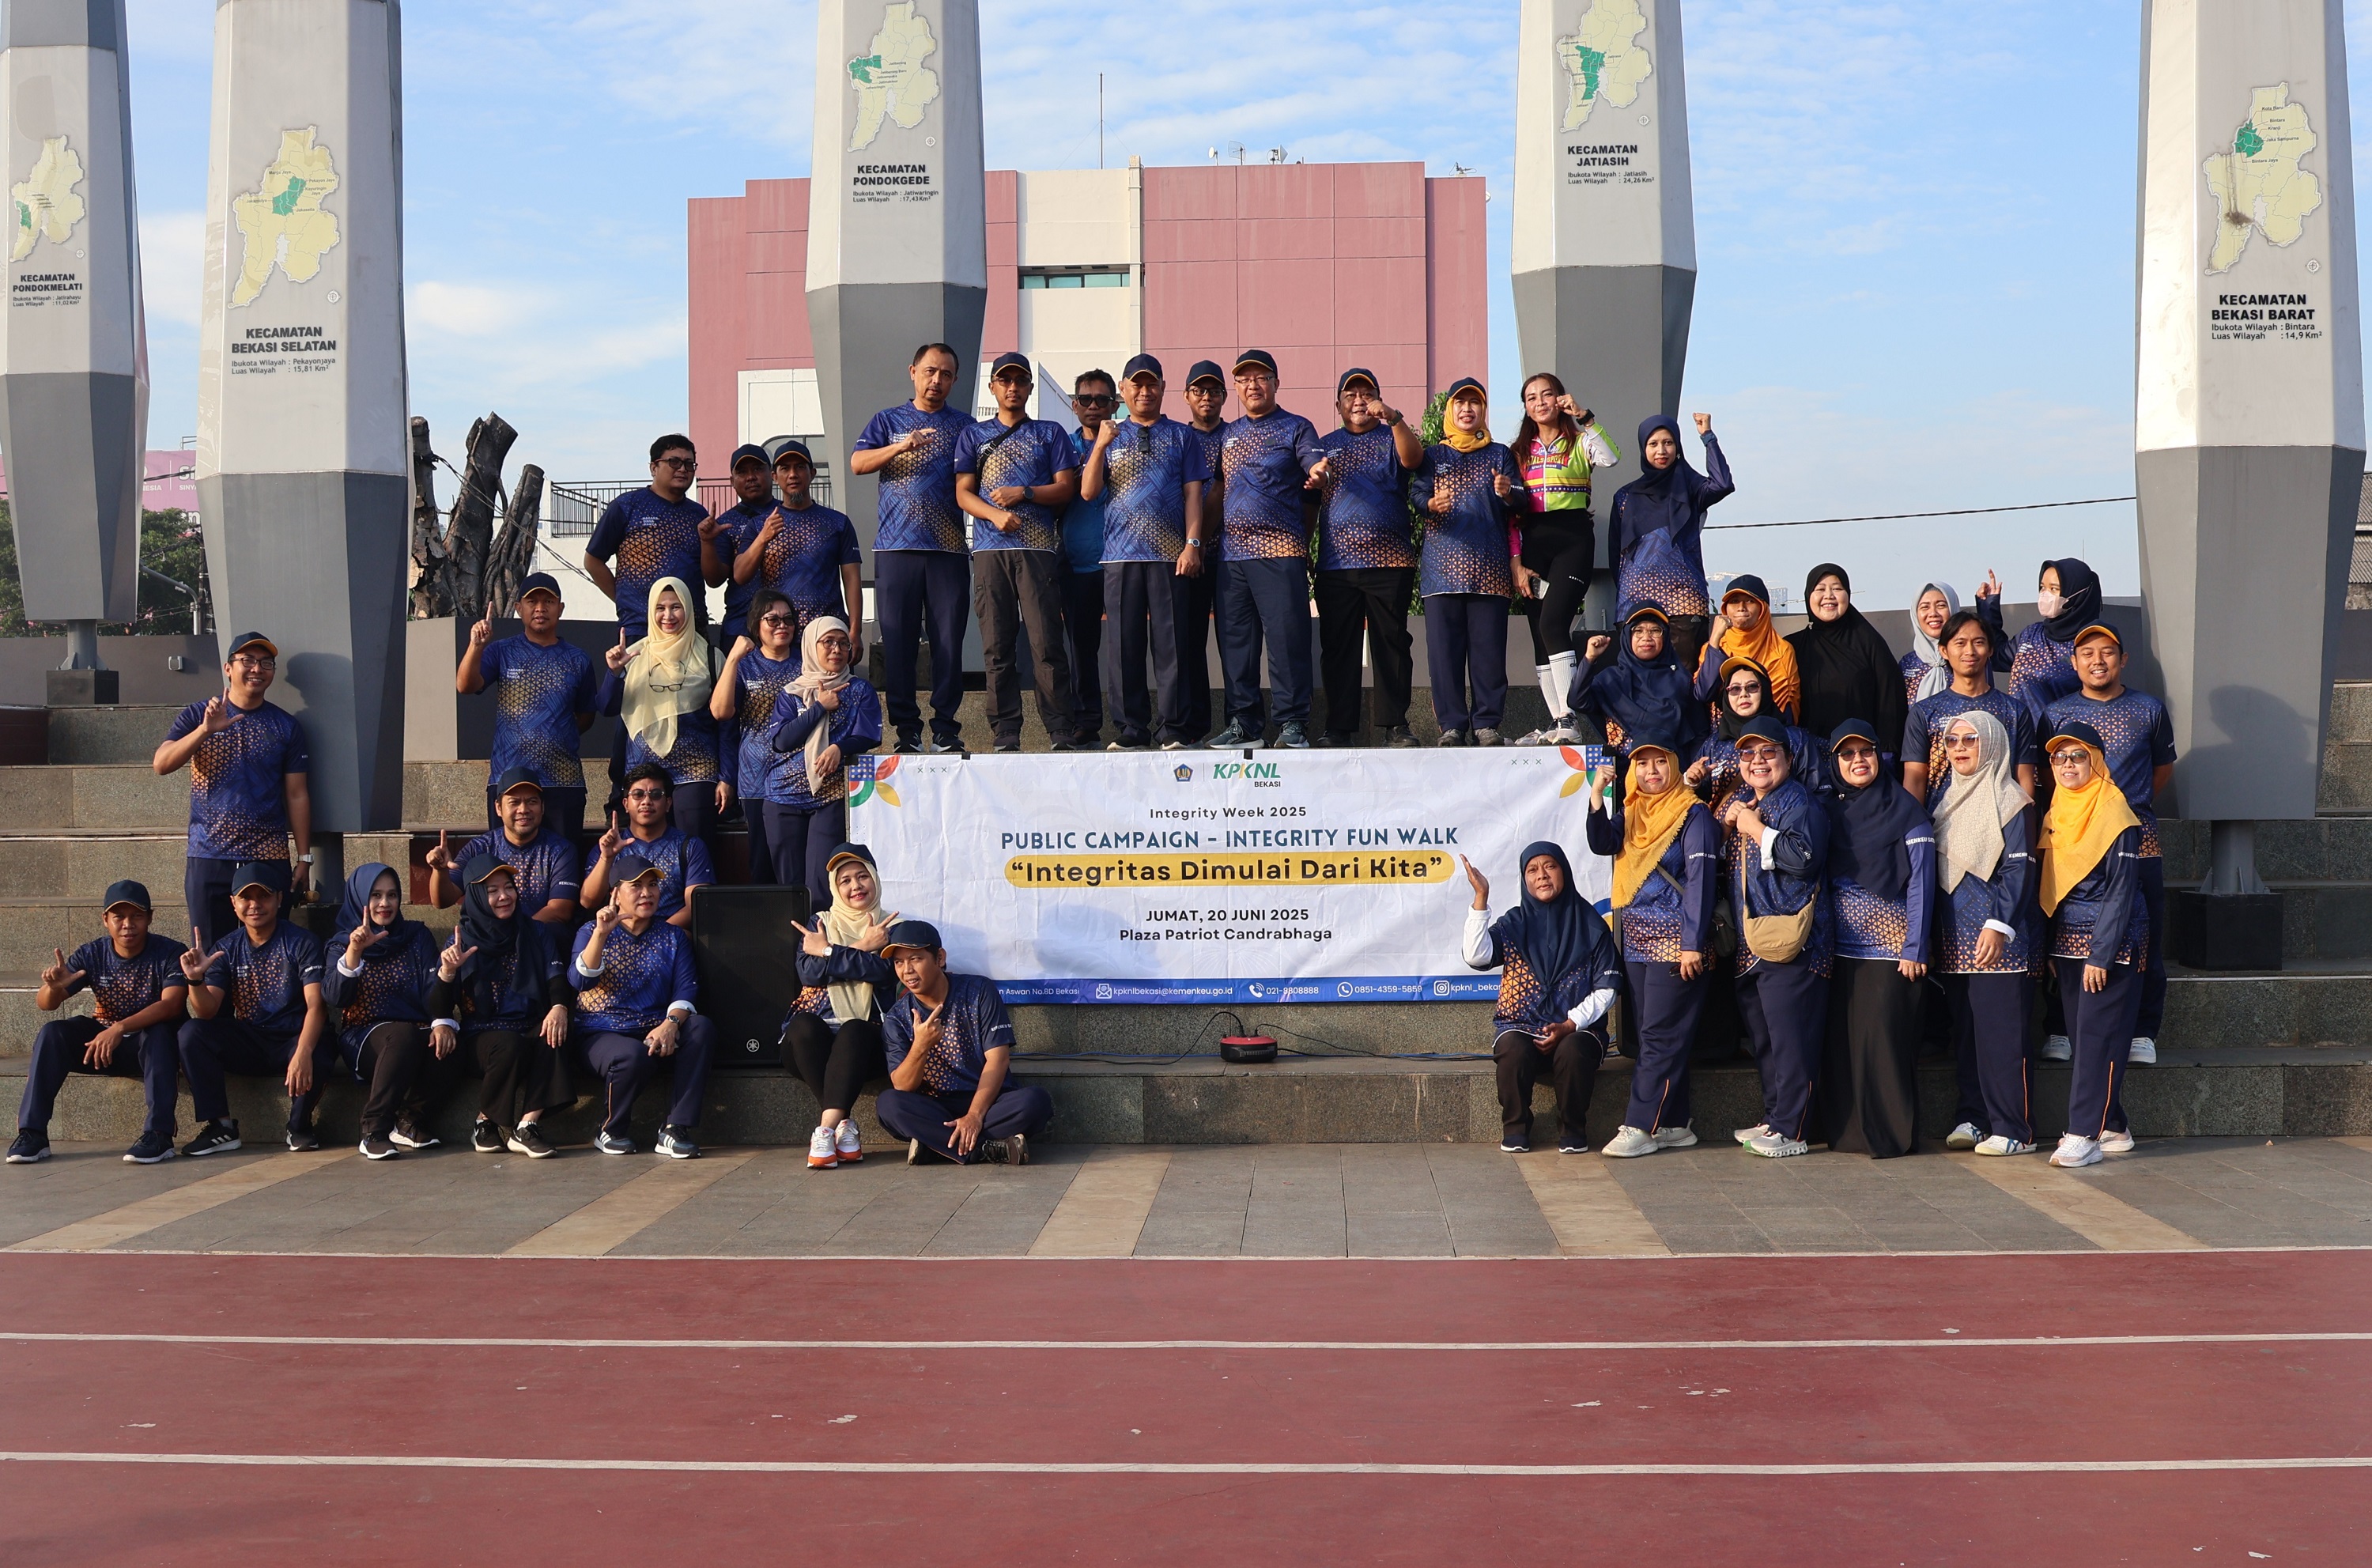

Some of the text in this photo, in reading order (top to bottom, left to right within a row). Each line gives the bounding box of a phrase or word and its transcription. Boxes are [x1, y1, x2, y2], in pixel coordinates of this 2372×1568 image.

[1567, 145, 1637, 155] KECAMATAN
[1577, 157, 1629, 166] JATIASIH
[857, 164, 926, 174] KECAMATAN
[853, 176, 930, 185] PONDOKGEDE
[21, 274, 75, 282] KECAMATAN
[13, 283, 82, 293] PONDOKMELATI
[2219, 294, 2306, 305] KECAMATAN
[2211, 309, 2315, 320] BEKASI BARAT
[246, 327, 323, 338] KECAMATAN
[2245, 323, 2277, 332] Wilayah
[2233, 332, 2266, 342] Wilayah
[232, 340, 337, 353] BEKASI SELATAN
[1213, 762, 1282, 780] KPKNL
[1150, 807, 1306, 821] Integrity Week 2025
[1001, 832, 1076, 849] PUBLIC
[1085, 830, 1199, 849] CAMPAIGN
[1226, 829, 1339, 848] INTEGRITY
[1347, 828, 1388, 846] FUN
[1396, 827, 1458, 844] WALK
[1181, 859, 1290, 880] Dimulai
[1301, 856, 1359, 878] Dari
[1146, 909, 1309, 923] JUMAT, 20 JUNI 2025
[1120, 928, 1332, 942] Plaza Patriot Candrabhaga
[1113, 987, 1233, 997] kpknlbekasi@kemenkeu.go.id
[1354, 985, 1422, 994] 0851-4359-5859
